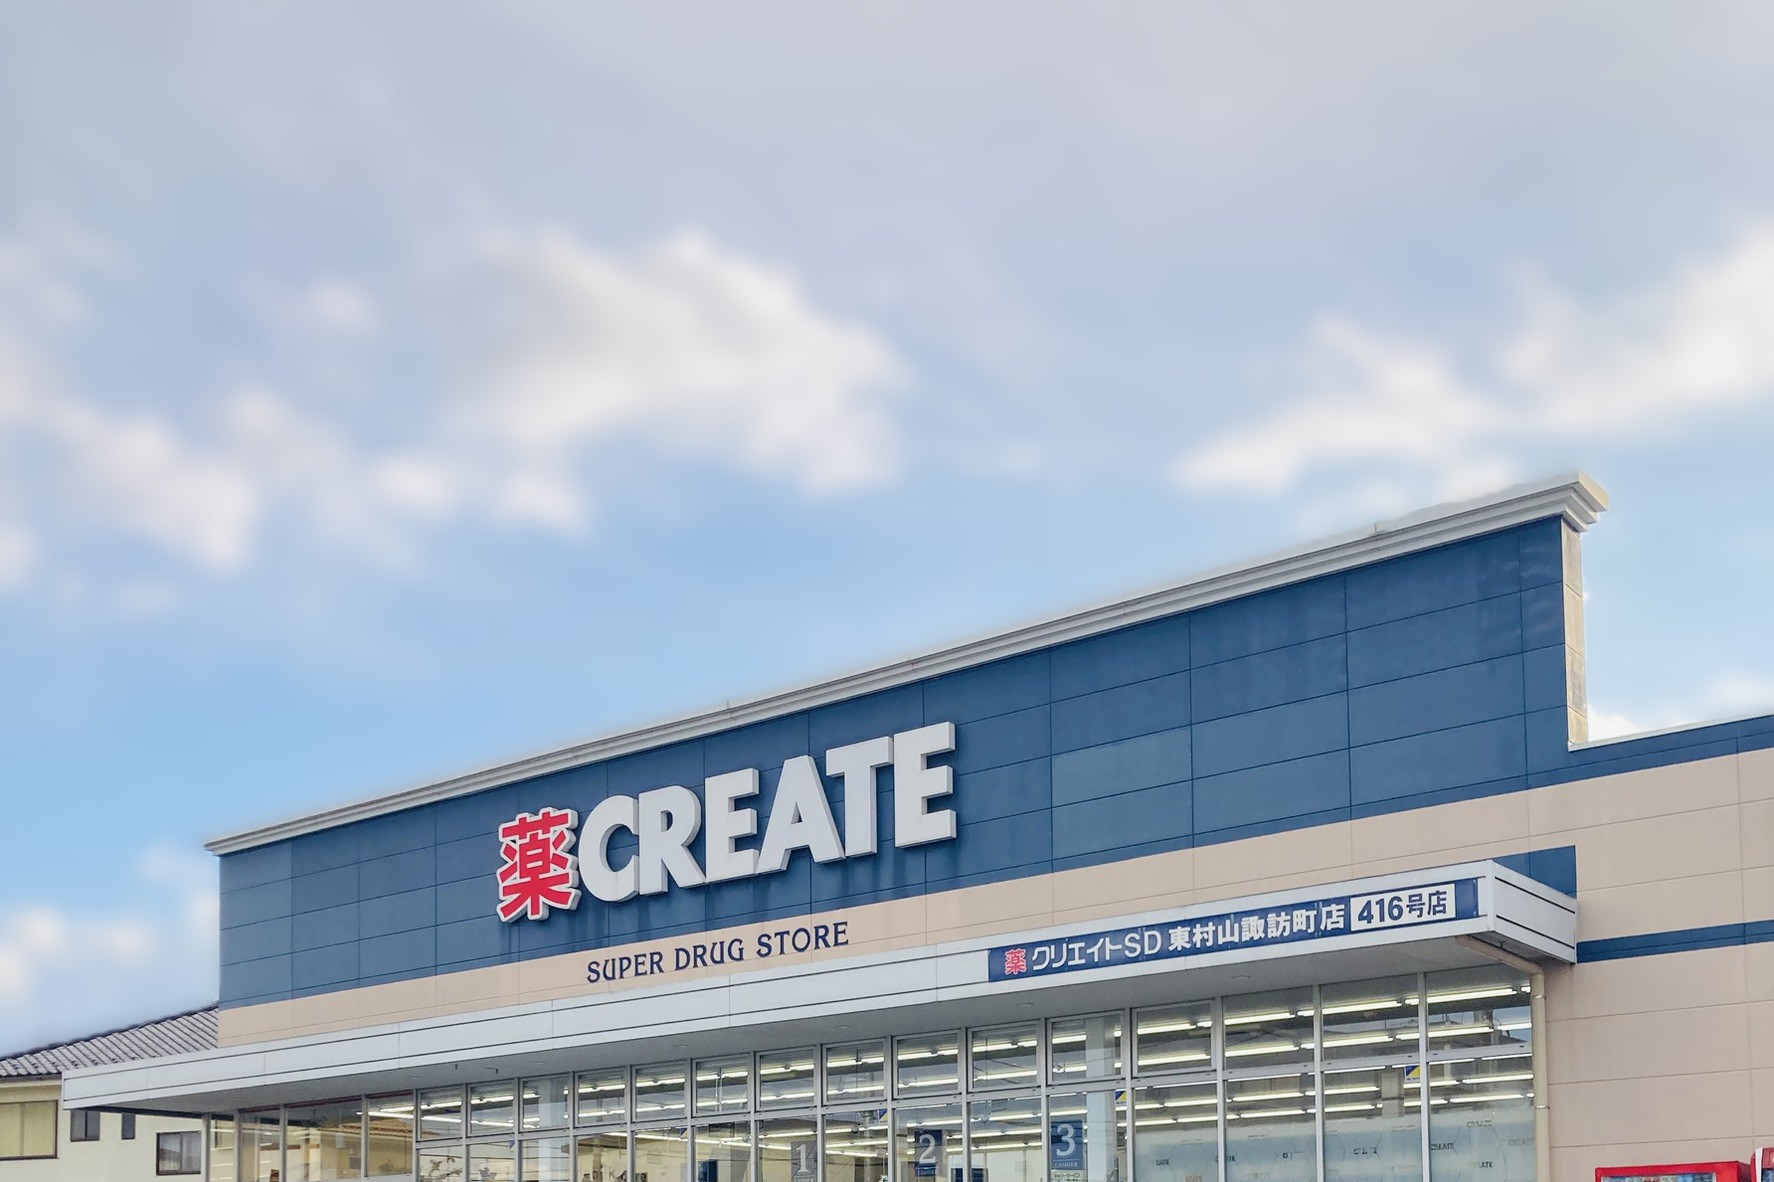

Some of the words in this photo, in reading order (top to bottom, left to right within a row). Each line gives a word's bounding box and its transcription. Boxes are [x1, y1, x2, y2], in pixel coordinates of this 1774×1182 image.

[496, 807, 580, 923] 薬
[579, 721, 957, 902] CREATE
[1358, 890, 1447, 924] 416号店
[586, 951, 664, 983] SUPER
[674, 938, 745, 971] DRUG
[756, 921, 849, 958] STORE
[1004, 948, 1027, 975] 薬
[918, 1133, 937, 1164] 2
[1056, 1123, 1076, 1156] 3
[795, 1144, 810, 1173] 1
